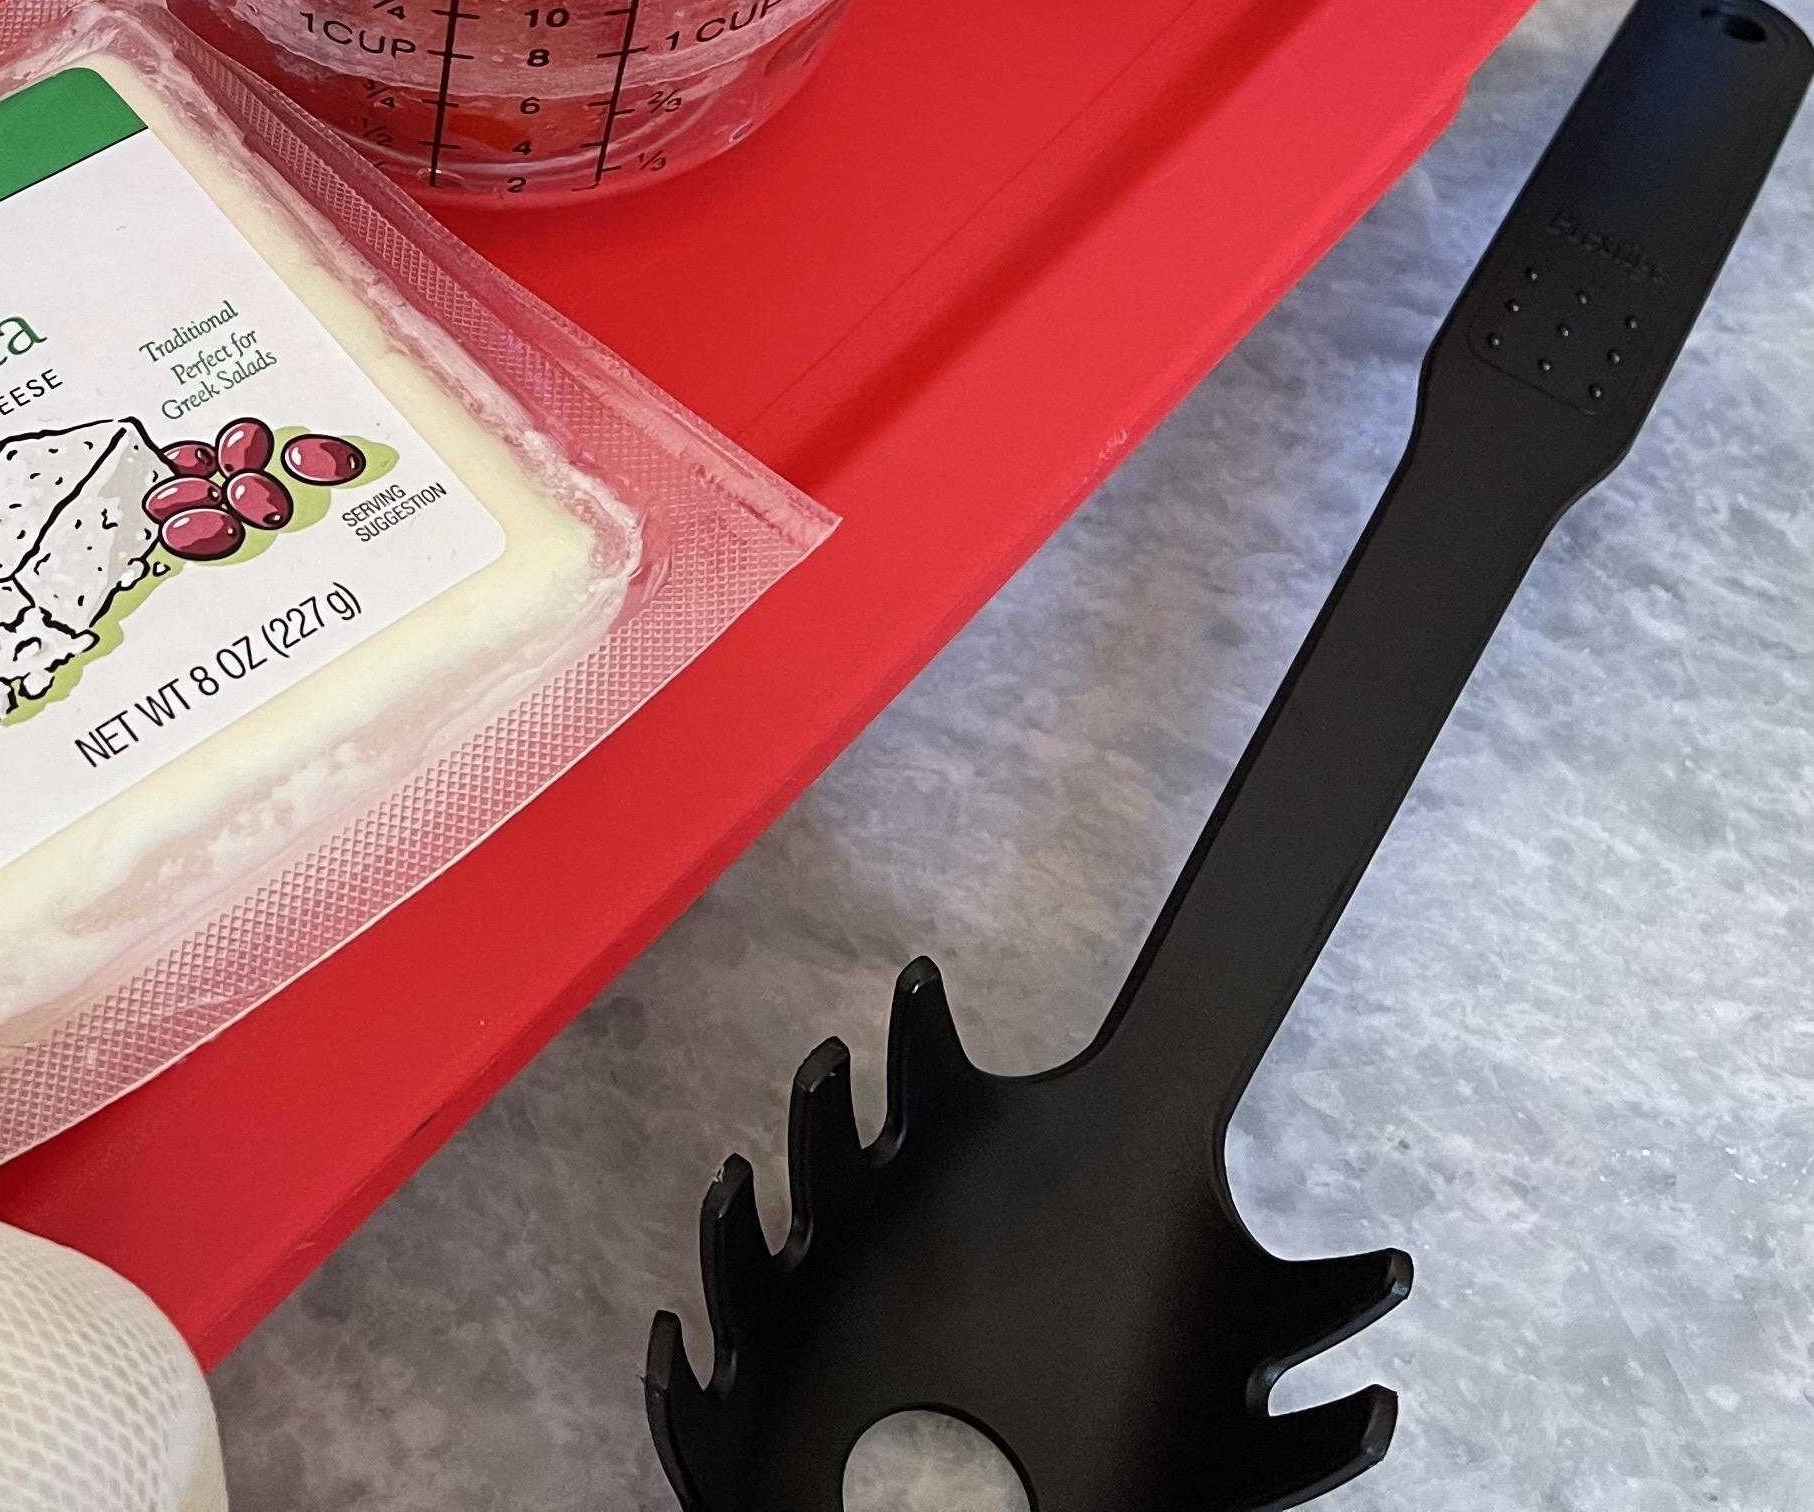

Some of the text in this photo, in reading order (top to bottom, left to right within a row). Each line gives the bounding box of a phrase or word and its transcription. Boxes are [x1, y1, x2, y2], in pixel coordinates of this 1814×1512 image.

[525, 9, 570, 28] 10
[527, 49, 550, 67] 8
[519, 97, 540, 114] 6
[512, 140, 532, 156] 4
[506, 177, 527, 194] 2
[139, 300, 240, 365] Traditional
[170, 327, 259, 386] Perfect for
[160, 349, 278, 422] Greek Salads
[341, 483, 408, 530] SERVING
[356, 481, 448, 543] SUGGESTION
[74, 582, 363, 770] NET WT 8 OZ (227 g)
